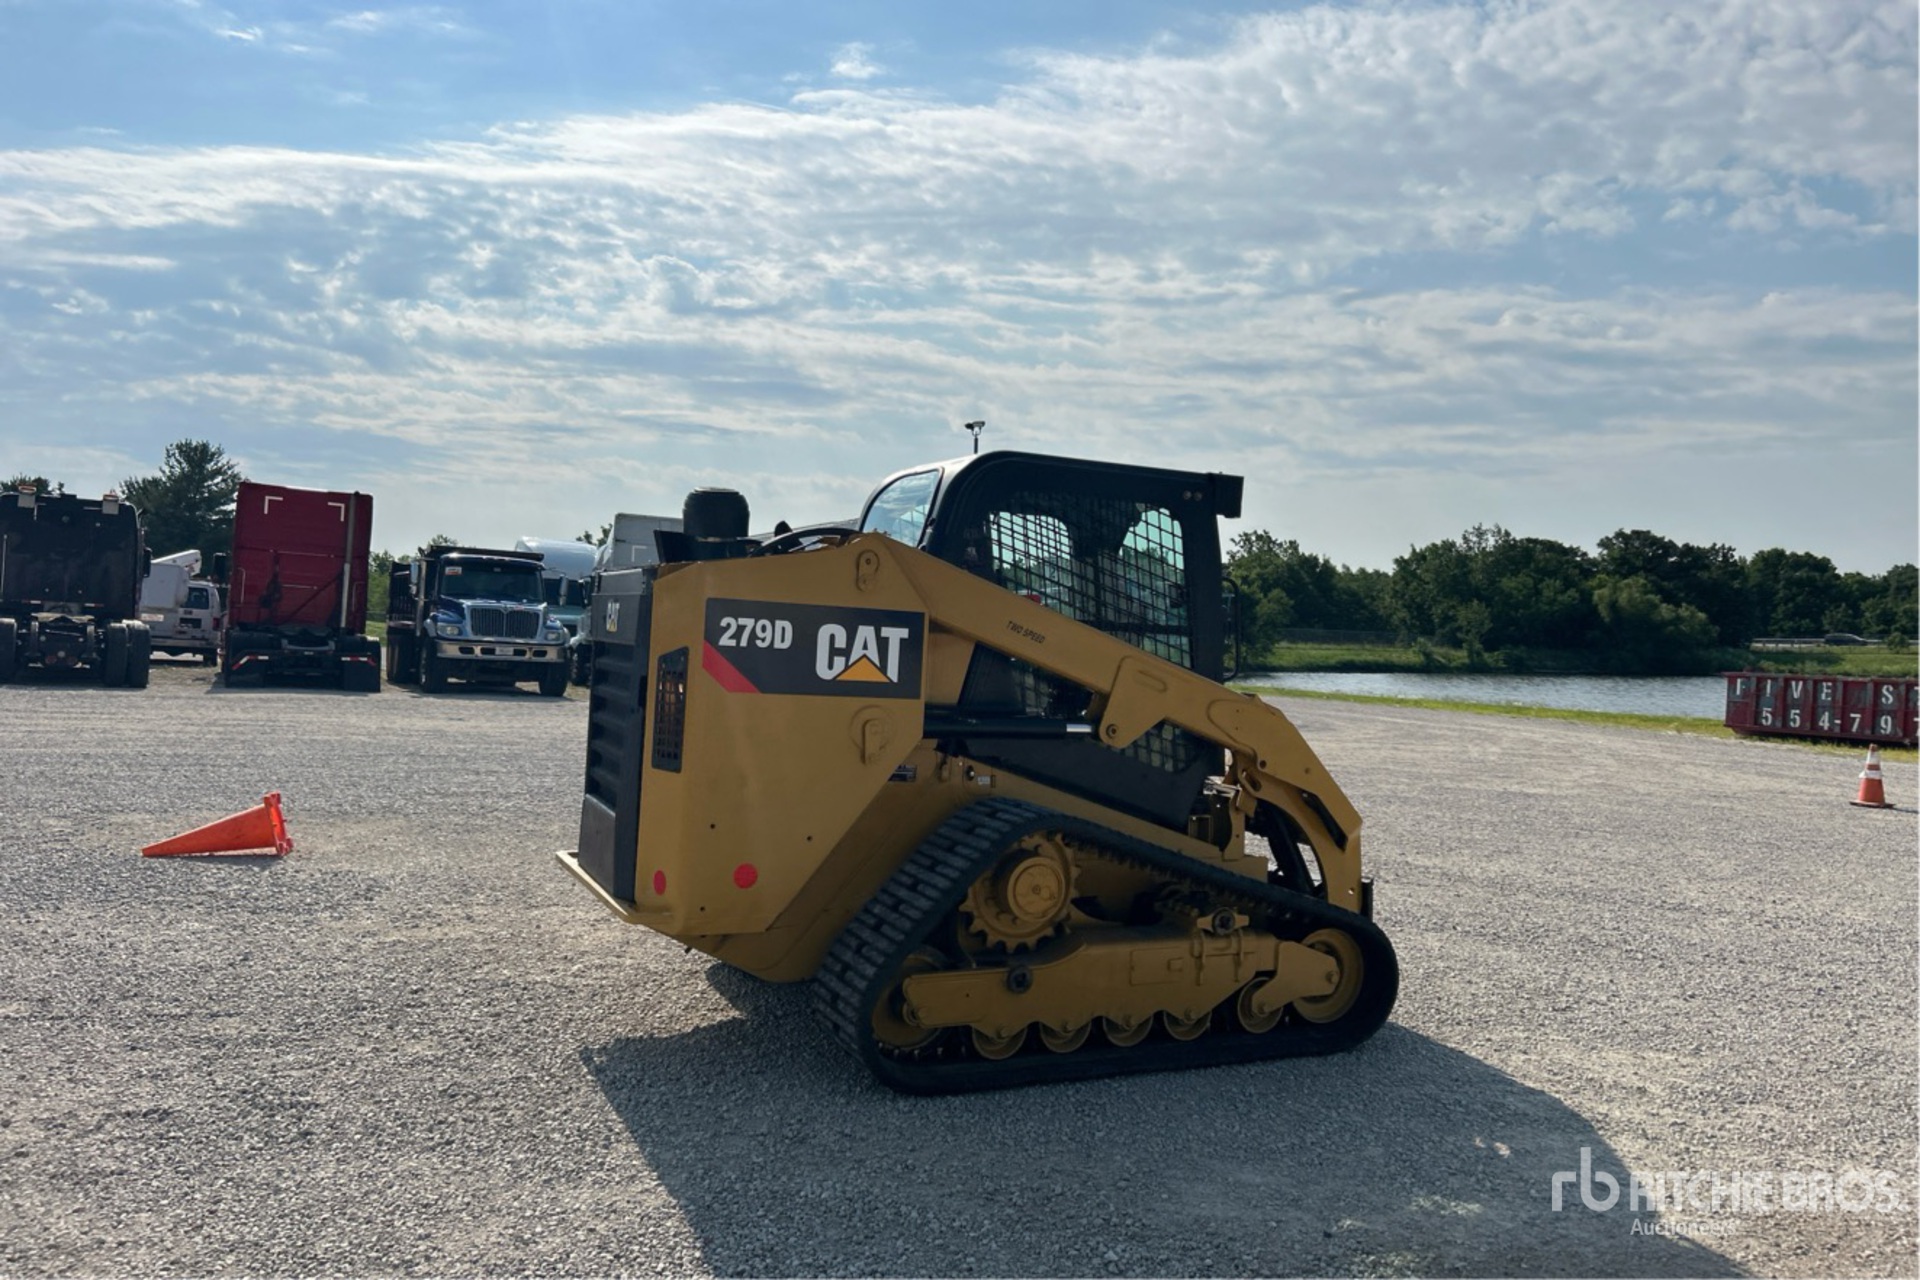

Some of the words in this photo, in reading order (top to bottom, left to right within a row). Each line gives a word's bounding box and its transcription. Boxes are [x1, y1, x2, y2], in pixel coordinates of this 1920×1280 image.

[1023, 628, 1046, 644] SPEED
[718, 616, 794, 650] 279D
[815, 623, 910, 683] CAT
[1736, 678, 1833, 701] FIVE
